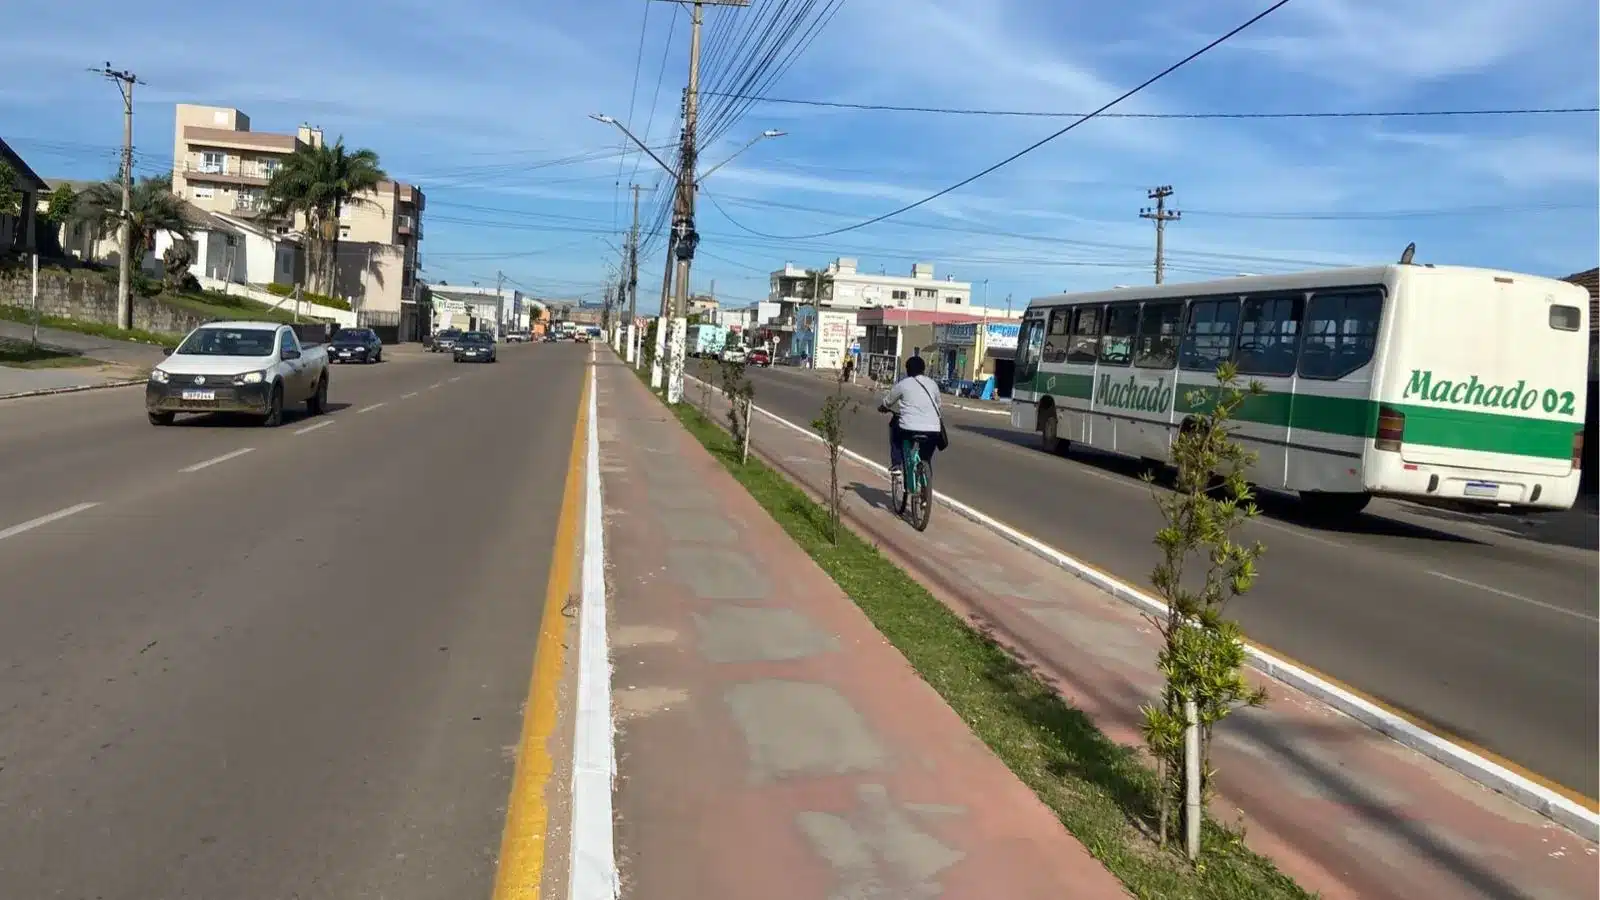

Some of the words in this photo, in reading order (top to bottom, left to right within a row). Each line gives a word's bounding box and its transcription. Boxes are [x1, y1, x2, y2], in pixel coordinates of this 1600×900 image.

[1095, 373, 1172, 413] Machado
[1403, 369, 1538, 411] Machado
[1542, 388, 1576, 416] 02
